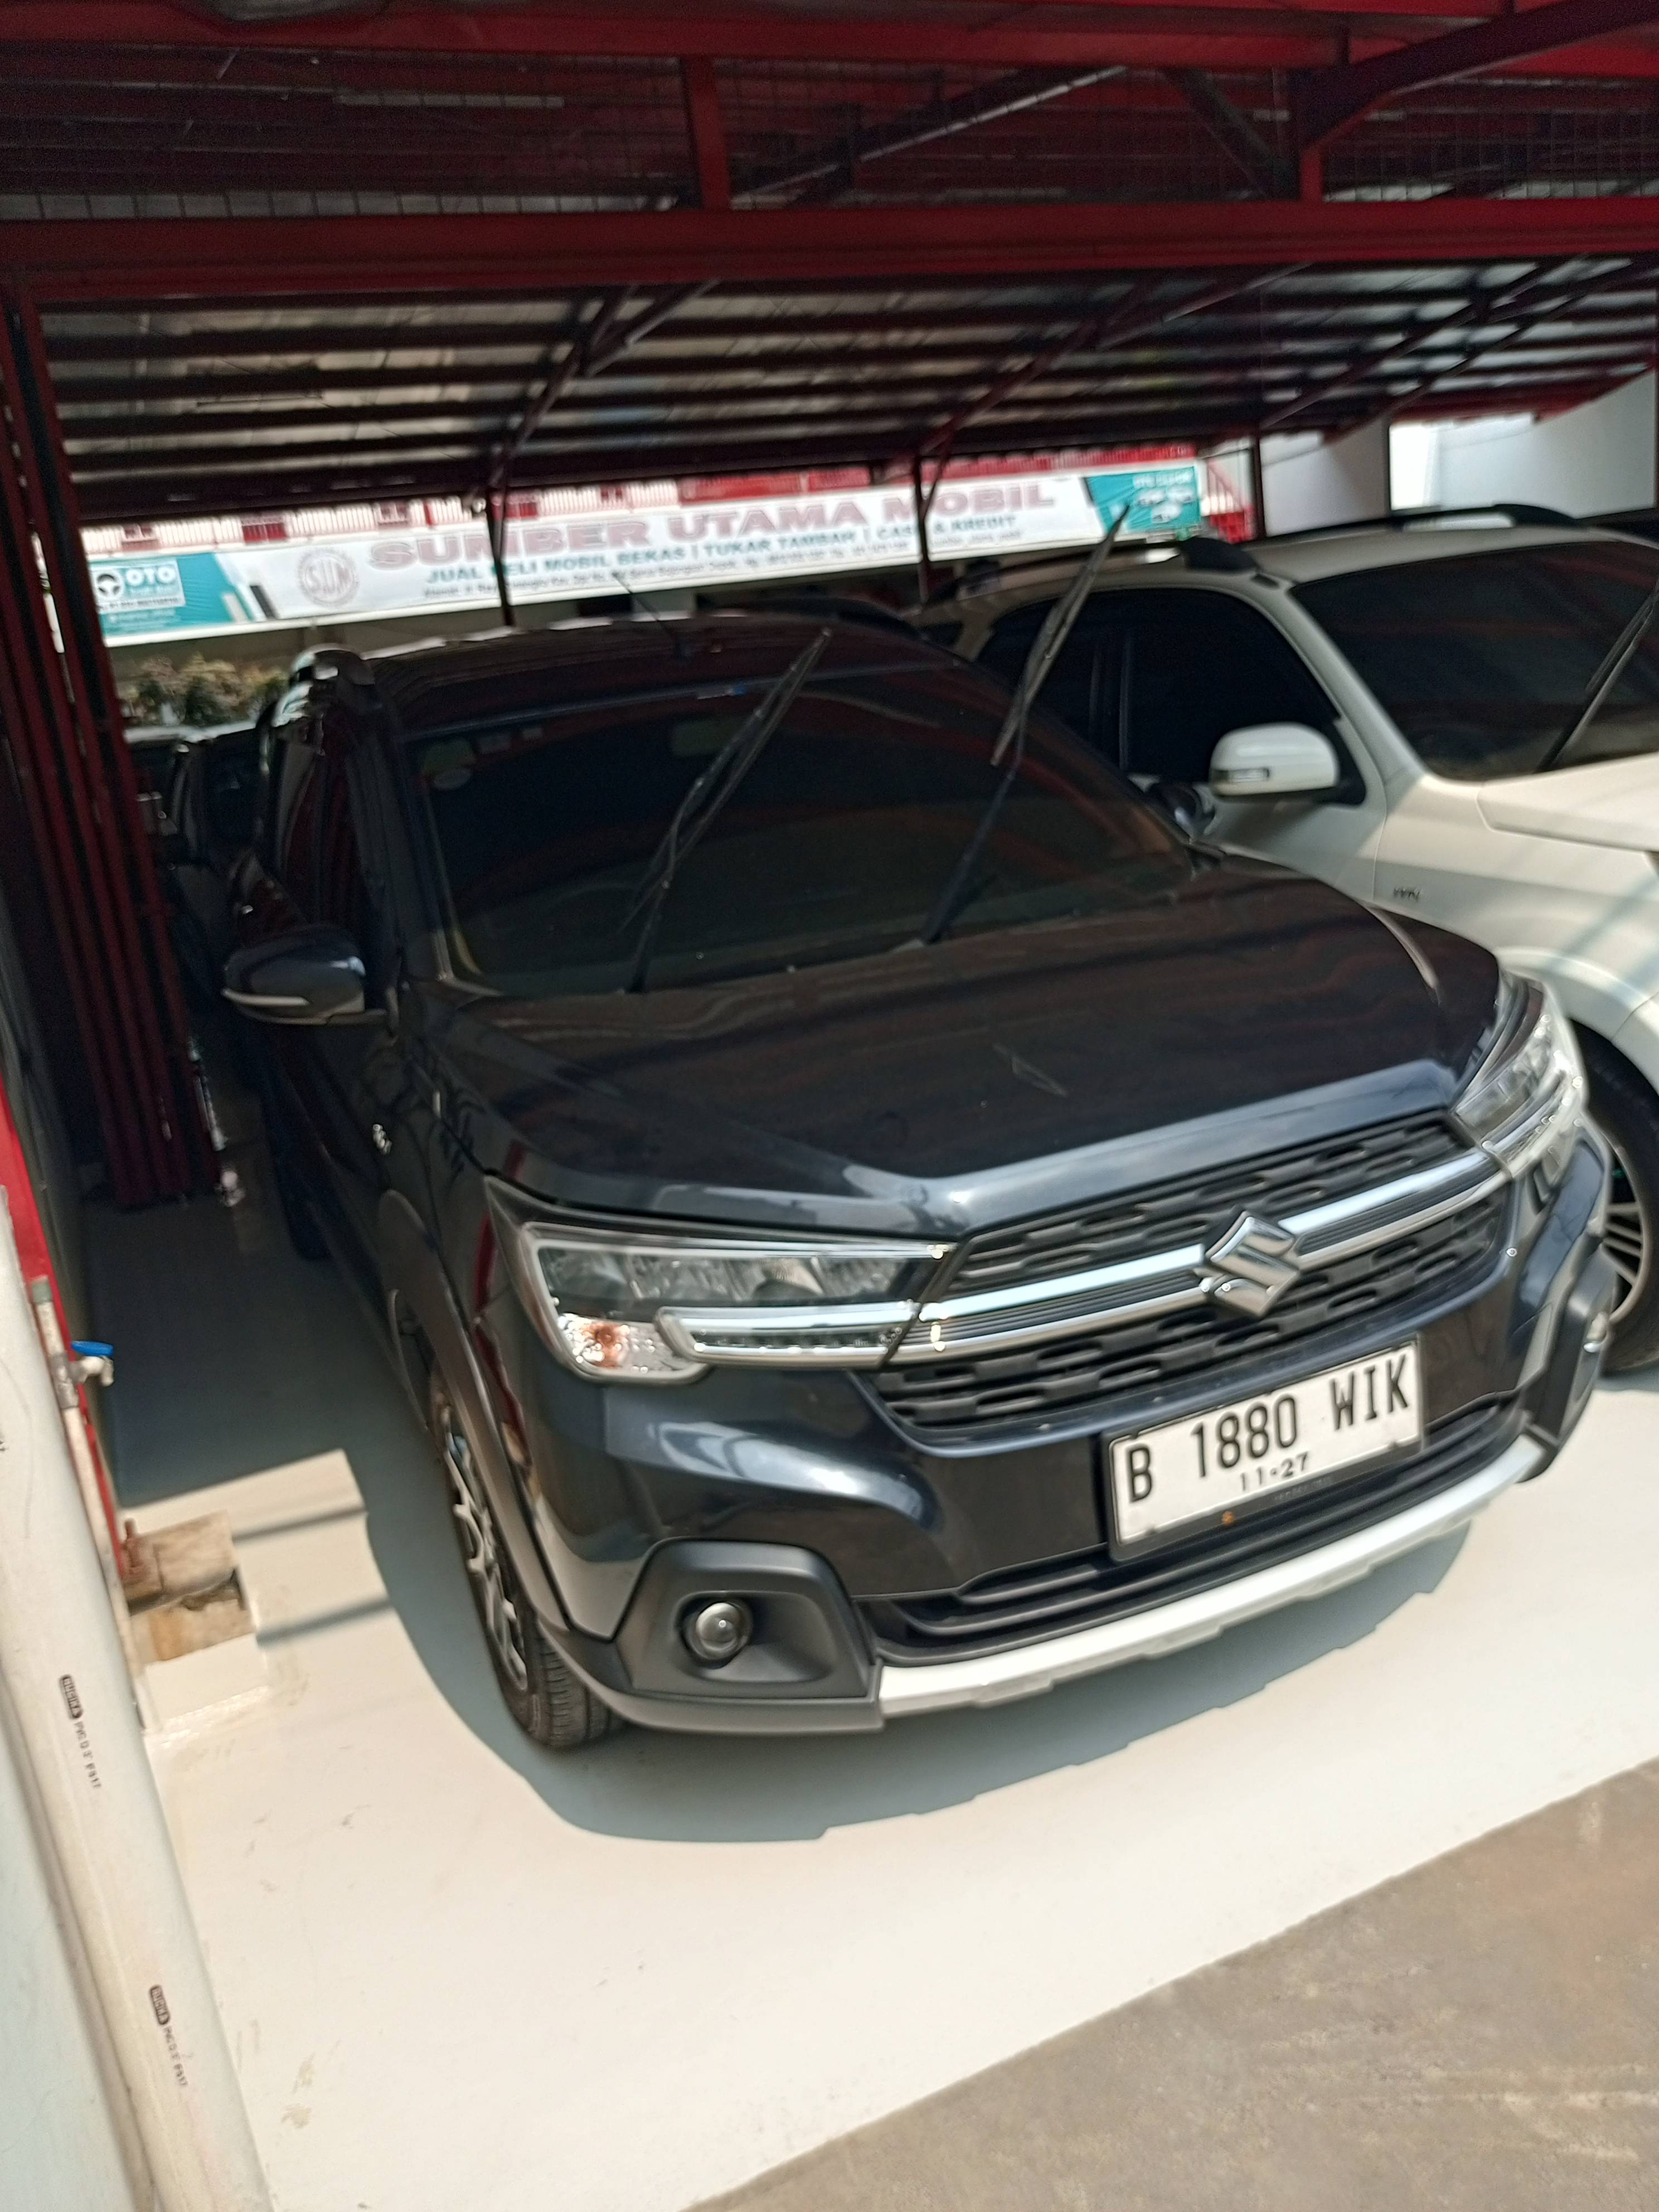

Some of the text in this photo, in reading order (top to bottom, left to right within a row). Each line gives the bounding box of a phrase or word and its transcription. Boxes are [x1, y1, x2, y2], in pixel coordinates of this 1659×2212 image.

[368, 521, 651, 572] SUMBER
[667, 501, 870, 542] UTAMA
[882, 483, 1054, 525] MOBIL
[428, 564, 479, 584] JUAL
[545, 555, 608, 573] MOBIL
[617, 547, 685, 565] BEKAS
[704, 539, 772, 557] TUKAR
[876, 523, 918, 540] CAS
[951, 515, 1017, 532] KREDIT
[125, 565, 177, 586] OTO
[1127, 1354, 1409, 1503] B 1880 WIK
